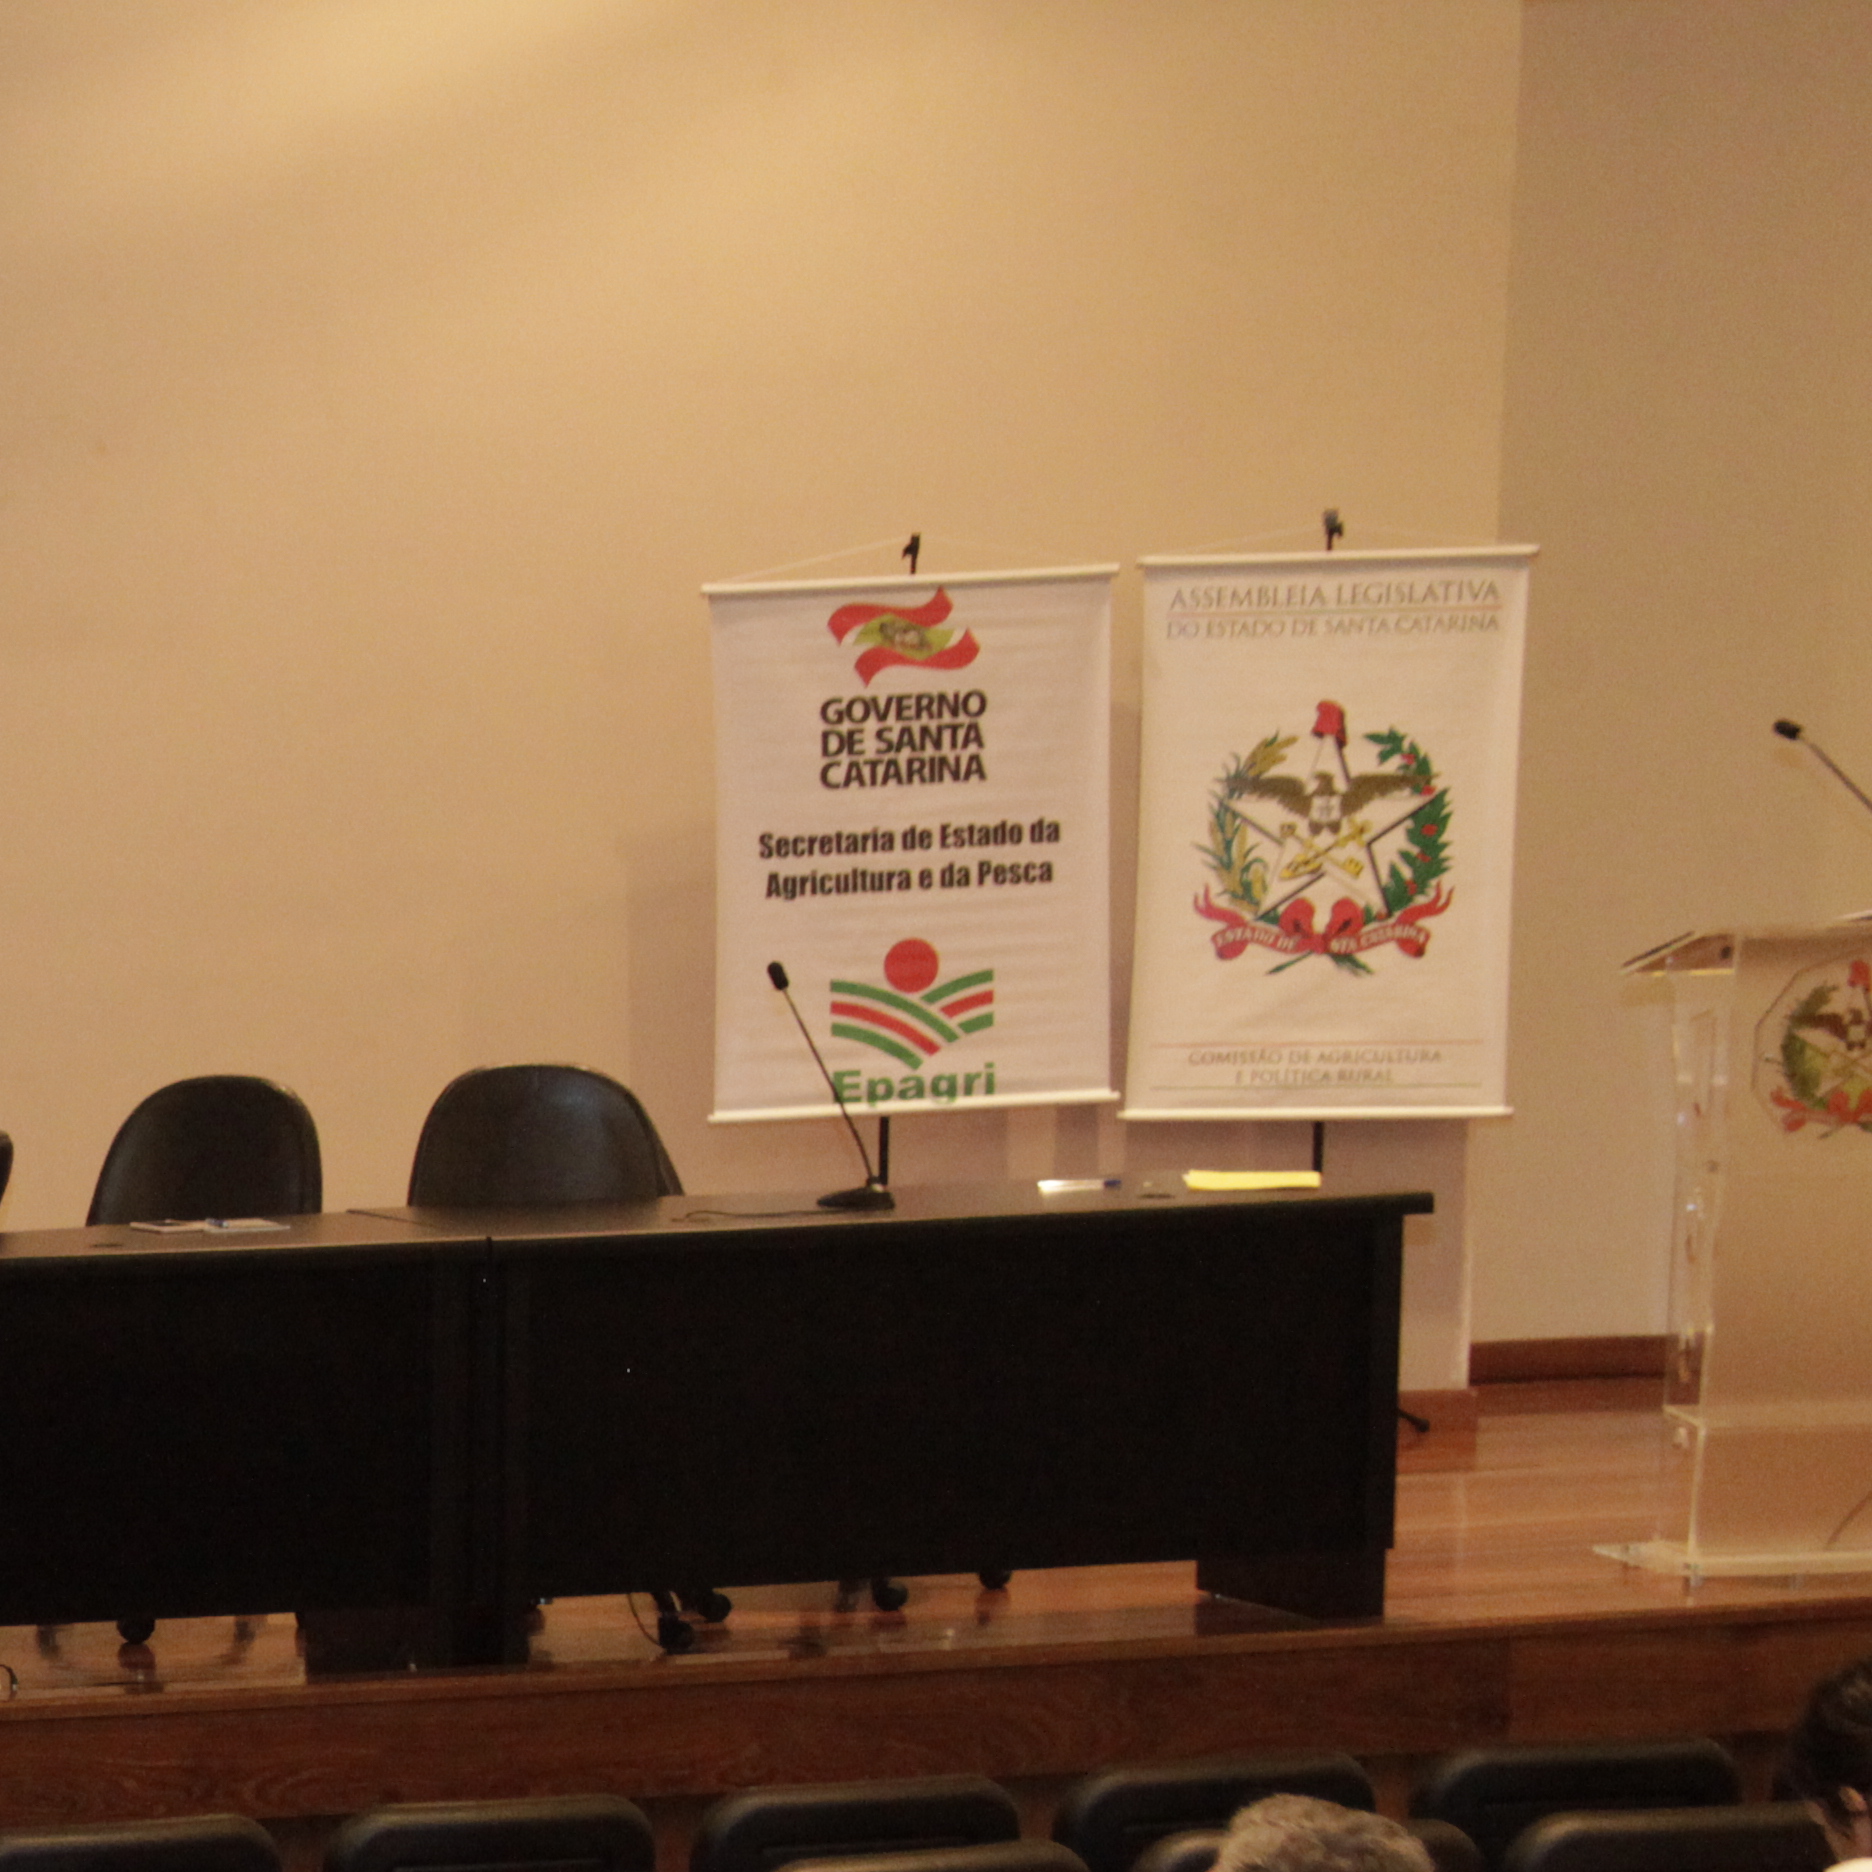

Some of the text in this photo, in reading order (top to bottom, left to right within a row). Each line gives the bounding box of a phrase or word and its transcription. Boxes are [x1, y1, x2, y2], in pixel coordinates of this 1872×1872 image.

[1169, 580, 1499, 610] ASSEMBLEIA LEGISLATIVA
[1167, 612, 1499, 640] DO ESTADO DE SANTA CATARINA
[820, 689, 987, 724] GOVERNO
[821, 723, 985, 758] DE SANTA
[820, 755, 987, 789] CATARINA
[759, 817, 1060, 860] Secretaria de Estado da
[766, 860, 1052, 901] Agricultura e da Pesca
[1317, 1049, 1442, 1064] AGRICULTURA
[833, 1062, 995, 1106] Epagri
